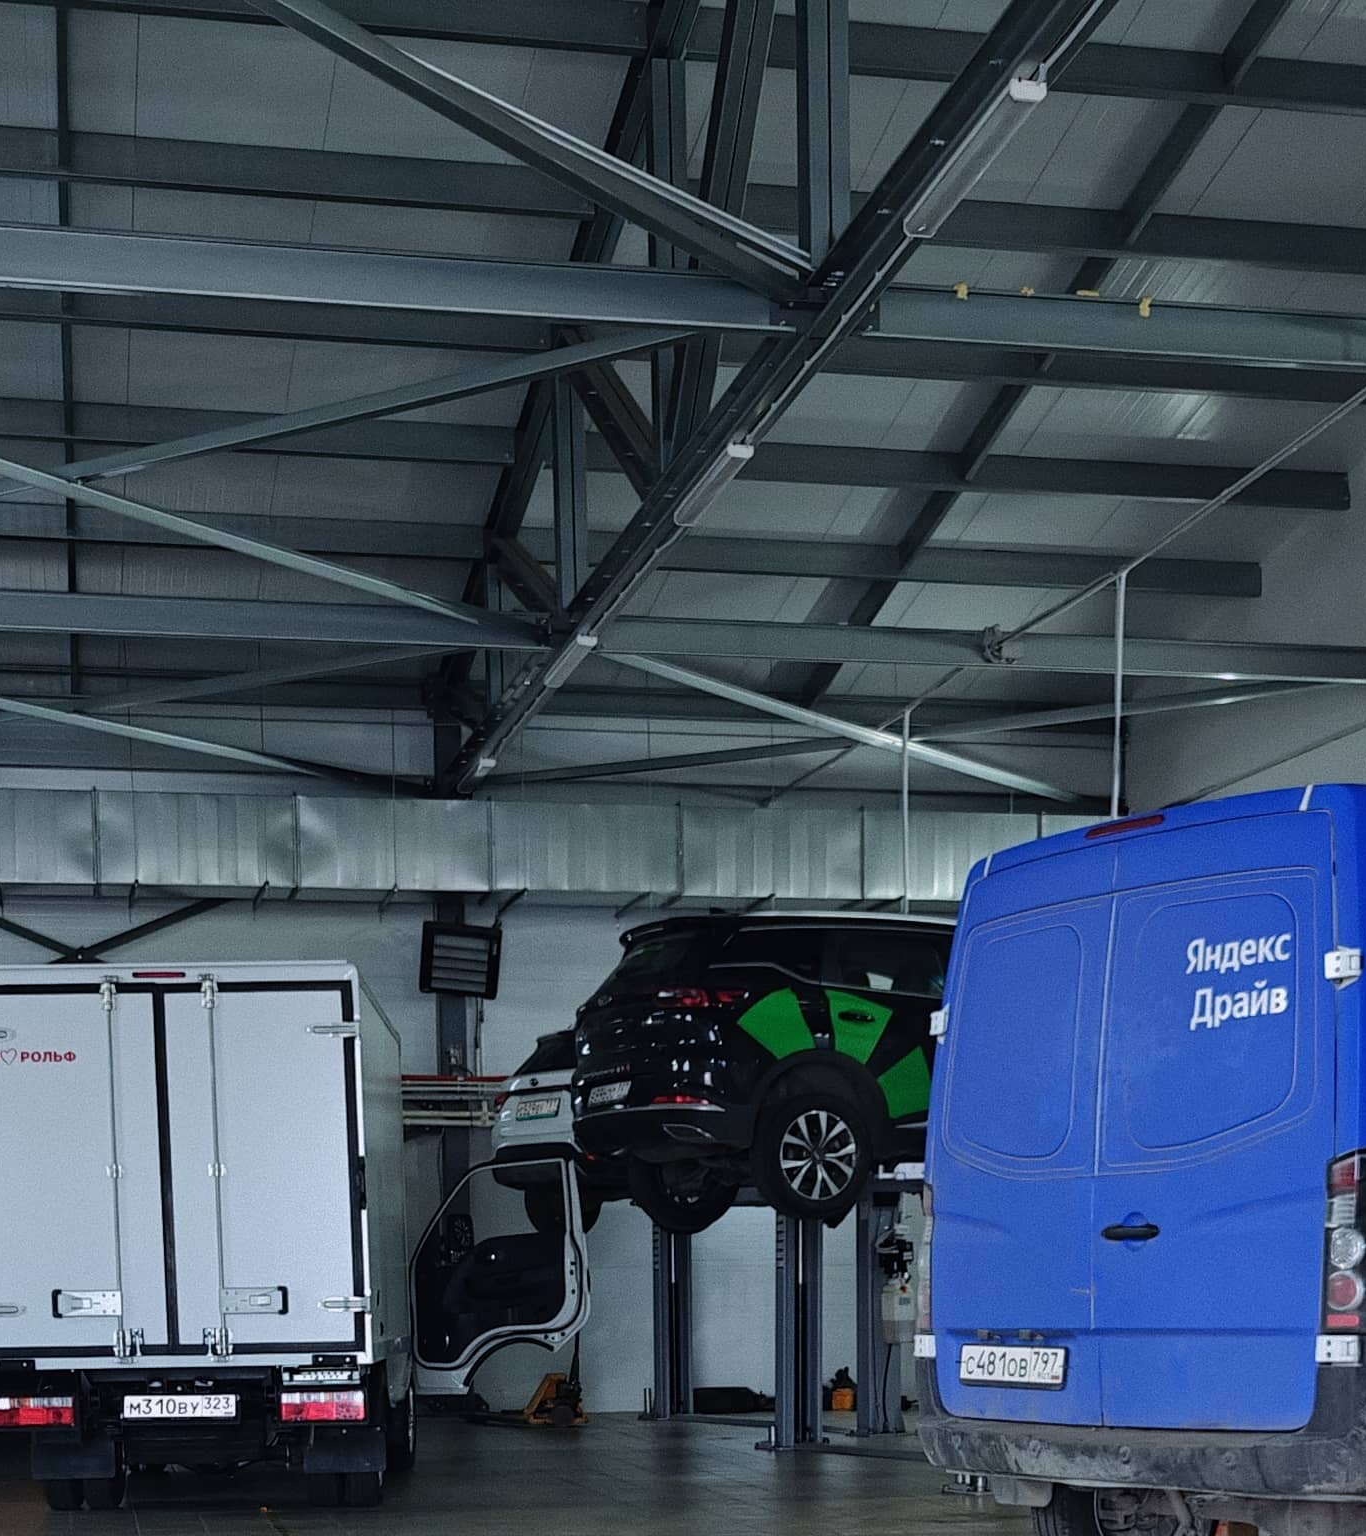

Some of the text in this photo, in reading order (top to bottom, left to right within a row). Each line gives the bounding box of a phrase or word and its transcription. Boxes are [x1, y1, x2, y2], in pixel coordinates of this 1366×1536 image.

[1185, 932, 1292, 975] Яндекс
[1189, 979, 1288, 1031] Драйв
[20, 1051, 77, 1063] РОЛЬФ
[965, 1349, 1059, 1378] С481ОВ 797
[129, 1396, 230, 1415] М310ВУ 323
